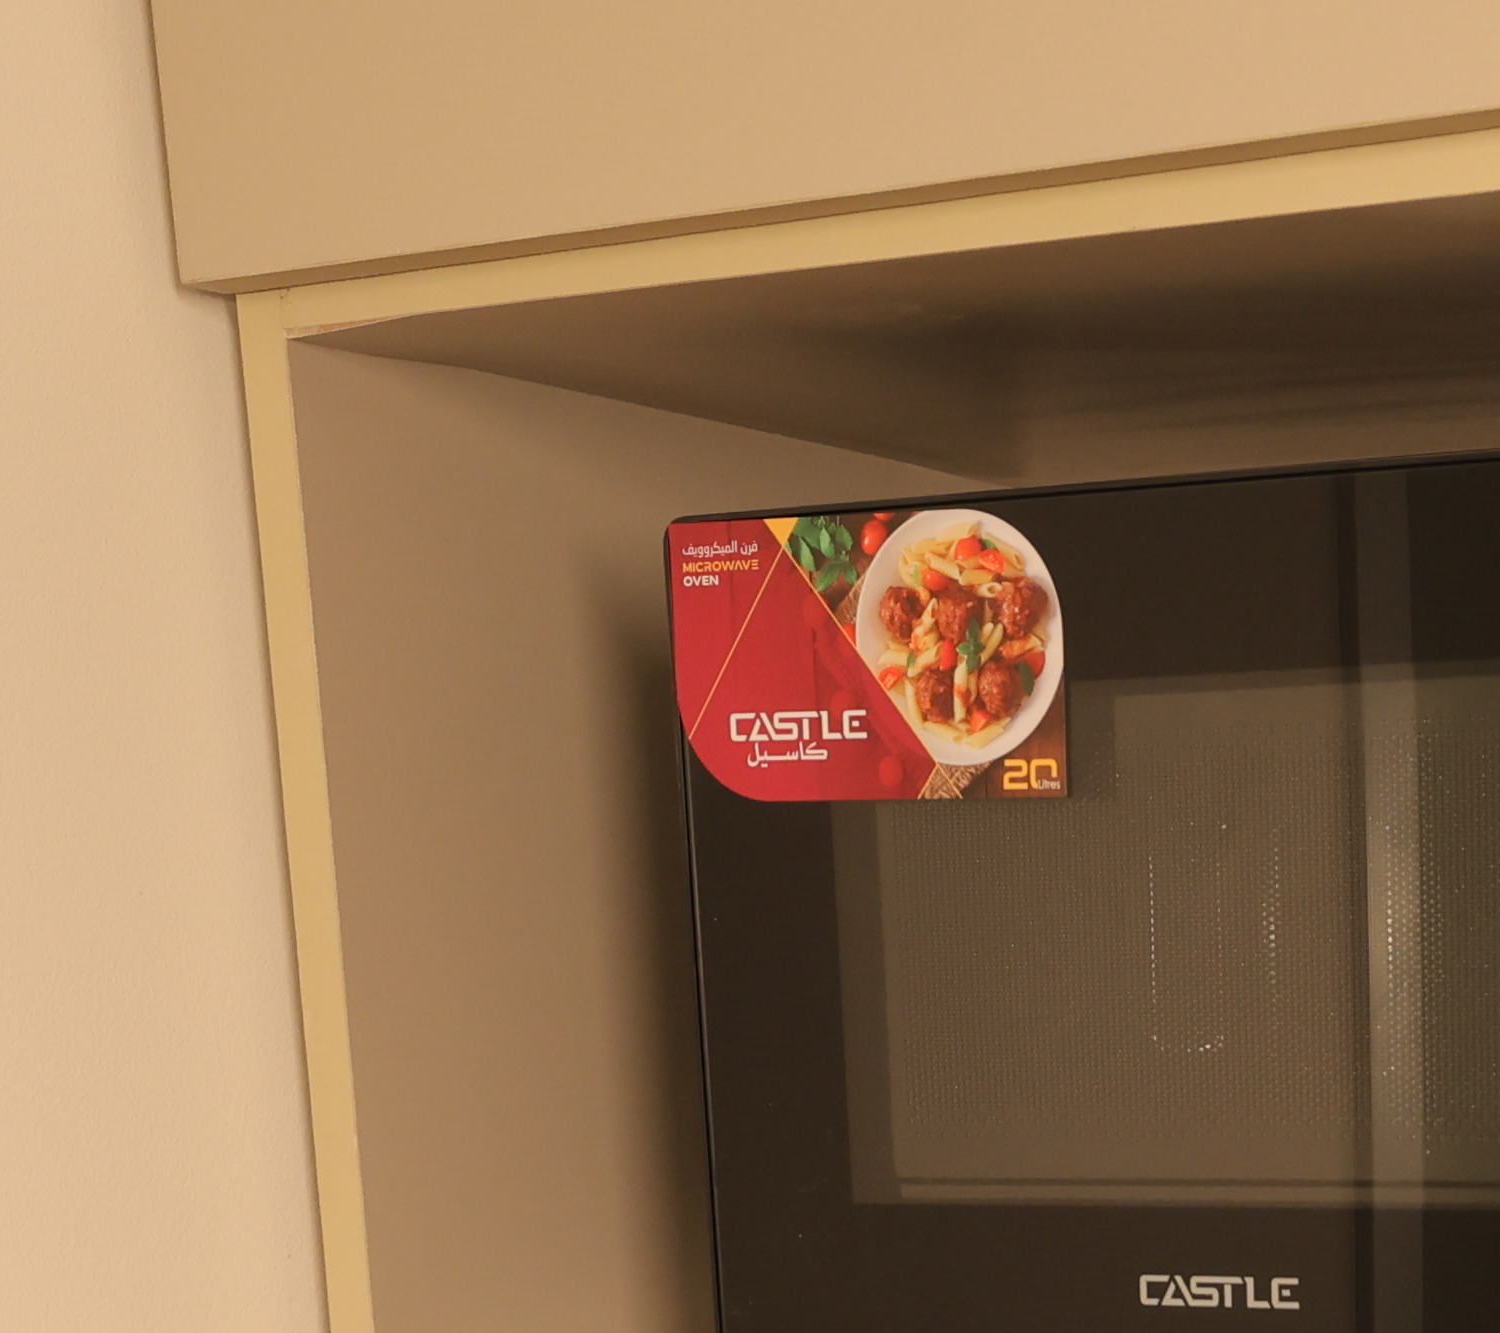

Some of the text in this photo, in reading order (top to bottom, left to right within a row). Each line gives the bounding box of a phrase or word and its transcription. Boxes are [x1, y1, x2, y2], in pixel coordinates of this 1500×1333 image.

[740, 540, 759, 556] فرن
[682, 559, 760, 573] MICROWAVE
[683, 574, 719, 587] OVEN
[729, 709, 868, 743] CASTLE
[1003, 758, 1058, 790] 20
[1139, 1274, 1301, 1310] CASTLE
